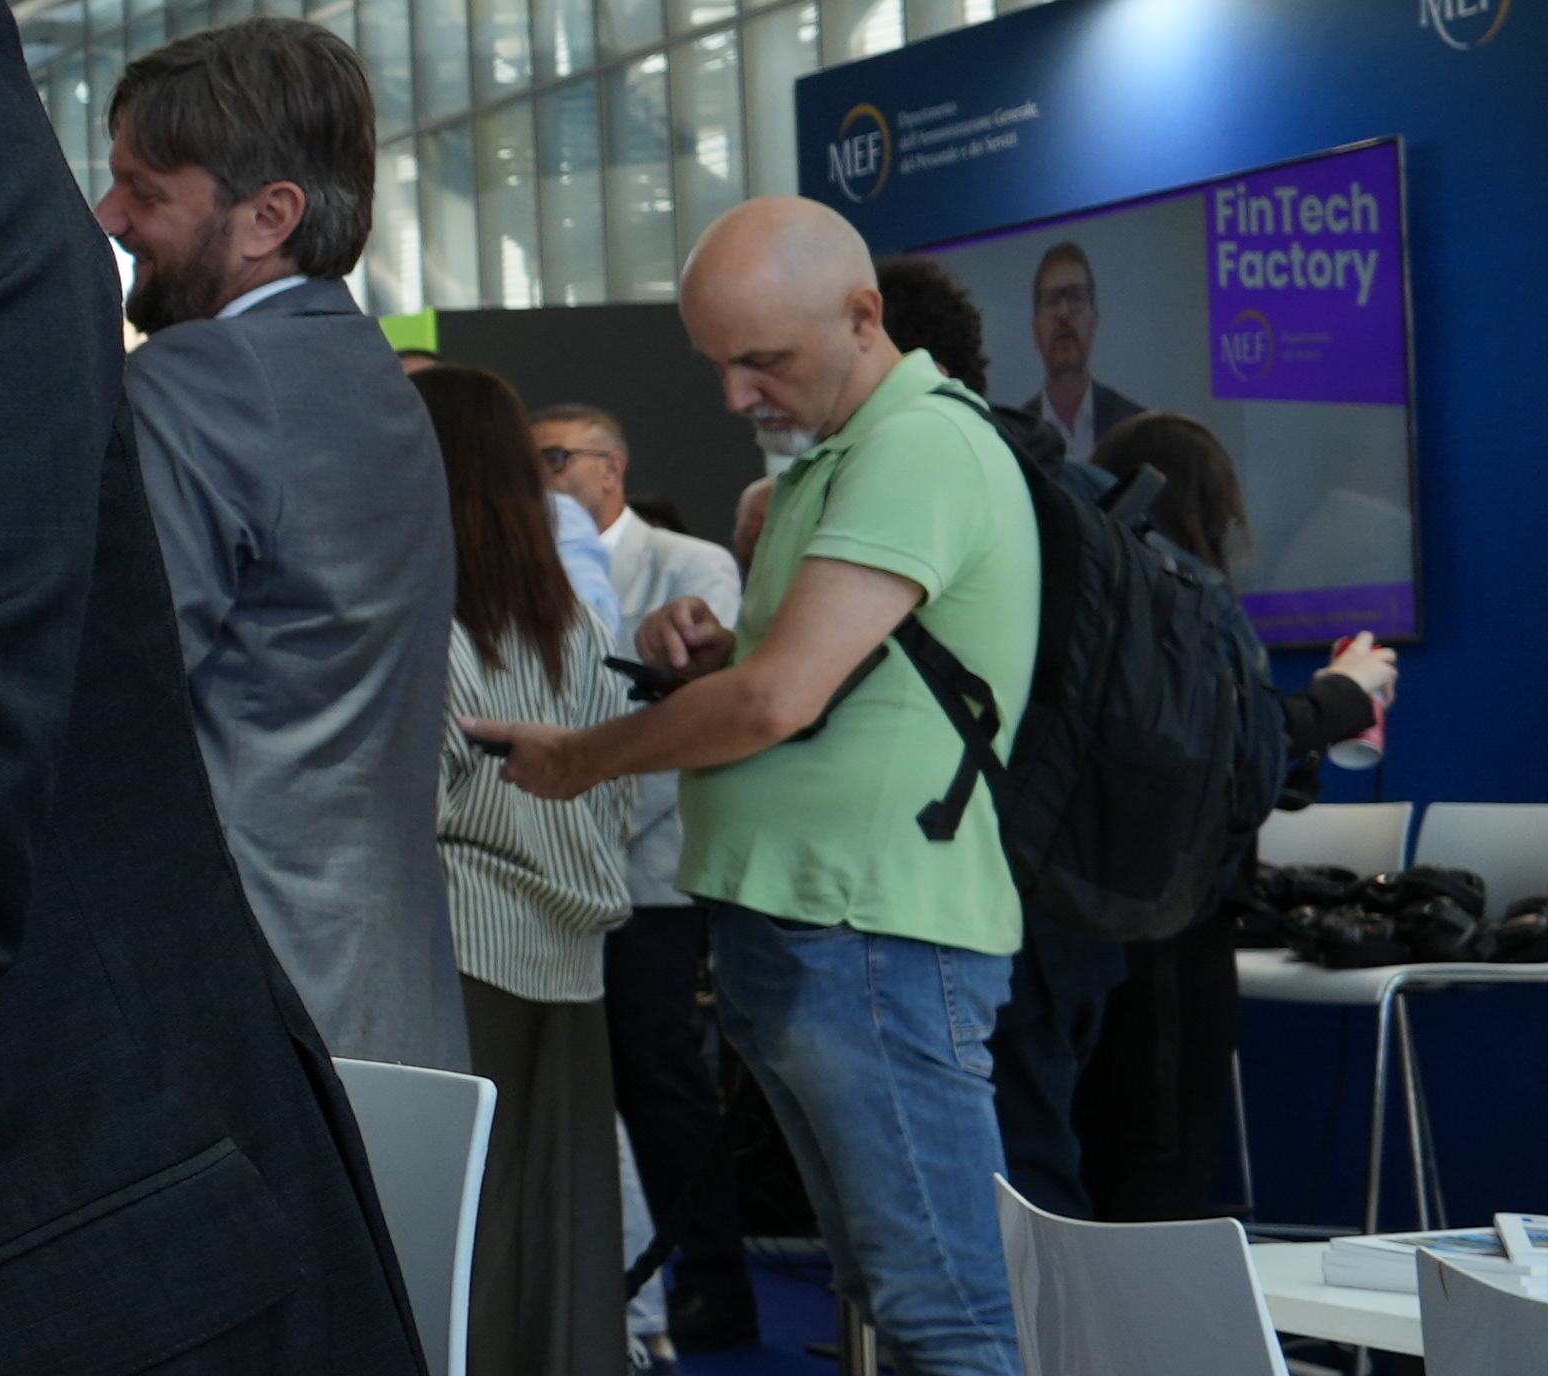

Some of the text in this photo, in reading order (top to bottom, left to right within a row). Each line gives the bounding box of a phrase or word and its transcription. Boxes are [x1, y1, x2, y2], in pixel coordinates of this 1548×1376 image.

[828, 130, 881, 183] MEF
[1216, 181, 1380, 236] FinTech
[1218, 241, 1380, 308] Factory
